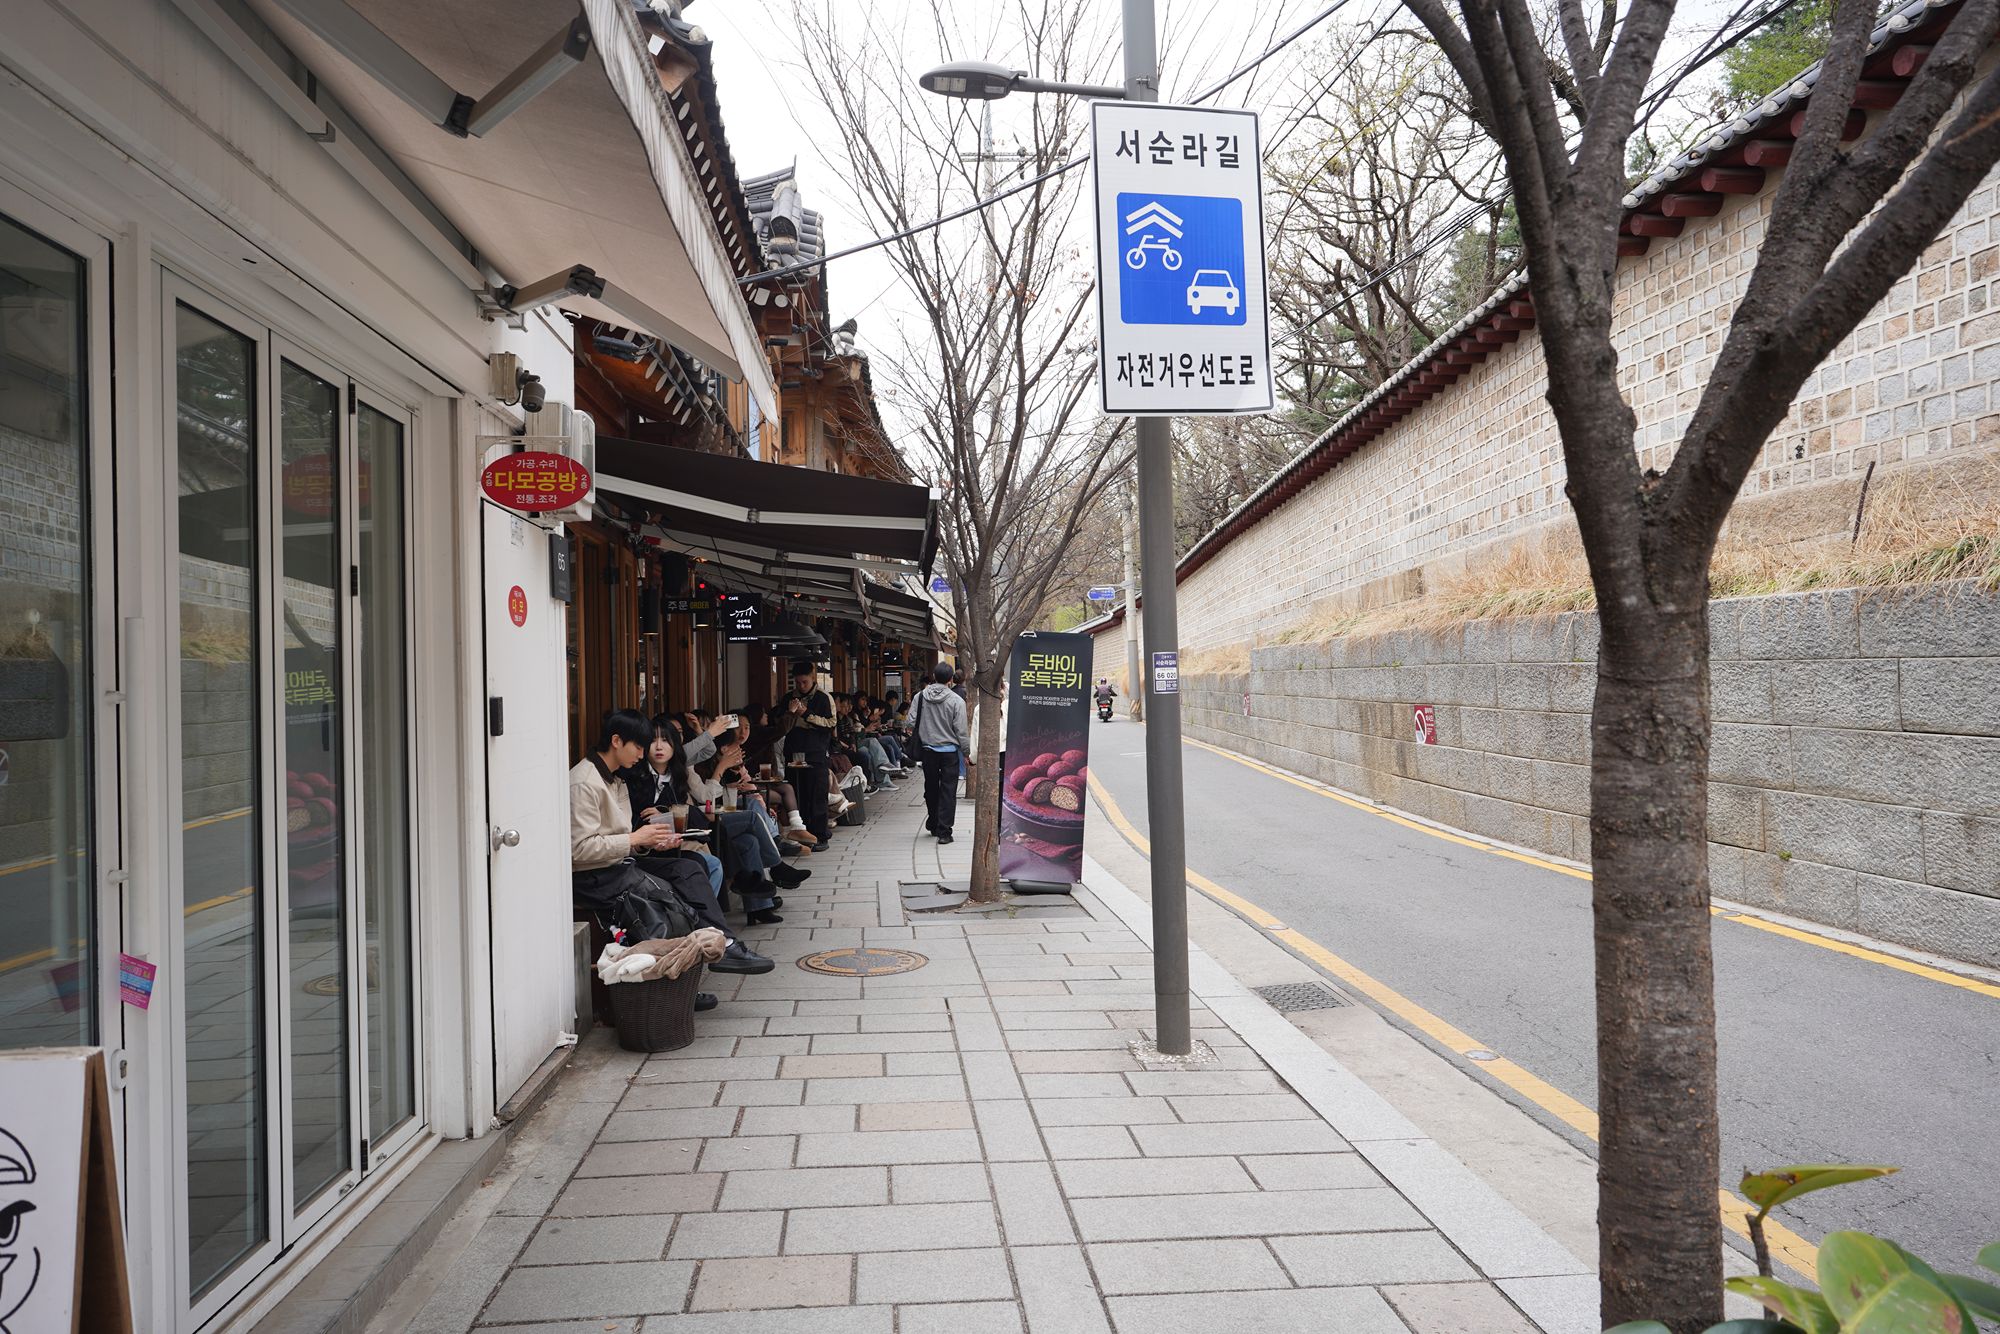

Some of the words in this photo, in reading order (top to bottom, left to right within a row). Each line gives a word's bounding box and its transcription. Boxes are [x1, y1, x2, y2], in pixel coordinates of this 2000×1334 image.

[1115, 129, 1240, 169] 서순라길
[1116, 352, 1256, 388] 자전거우선도로
[494, 471, 578, 492] 다모공방
[667, 600, 688, 611] 주문
[1028, 653, 1076, 672] 두바이
[1020, 670, 1083, 690] 쫀득쿠키
